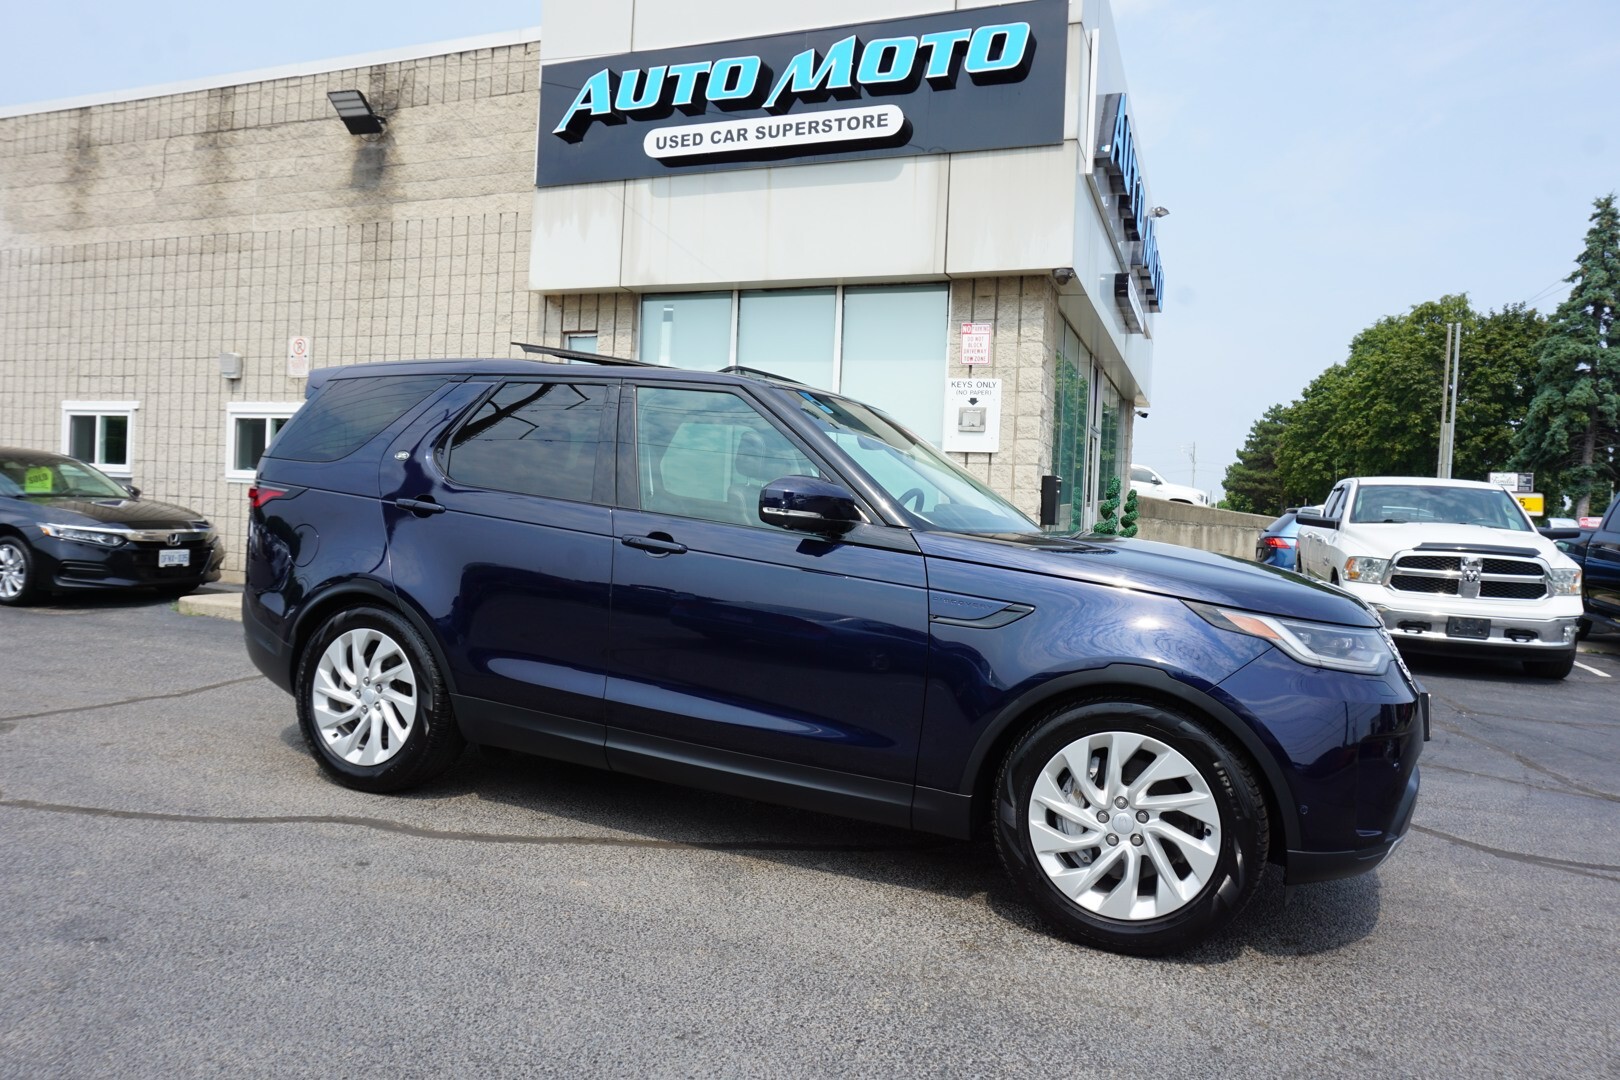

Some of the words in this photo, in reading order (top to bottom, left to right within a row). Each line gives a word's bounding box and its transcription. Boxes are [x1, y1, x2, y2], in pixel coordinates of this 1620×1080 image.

[552, 55, 761, 133] AUTO
[762, 22, 1031, 107] MOTO
[656, 133, 703, 149] USED
[710, 128, 748, 143] CAR
[755, 113, 888, 140] SUPERSTORE
[962, 325, 972, 333] NO
